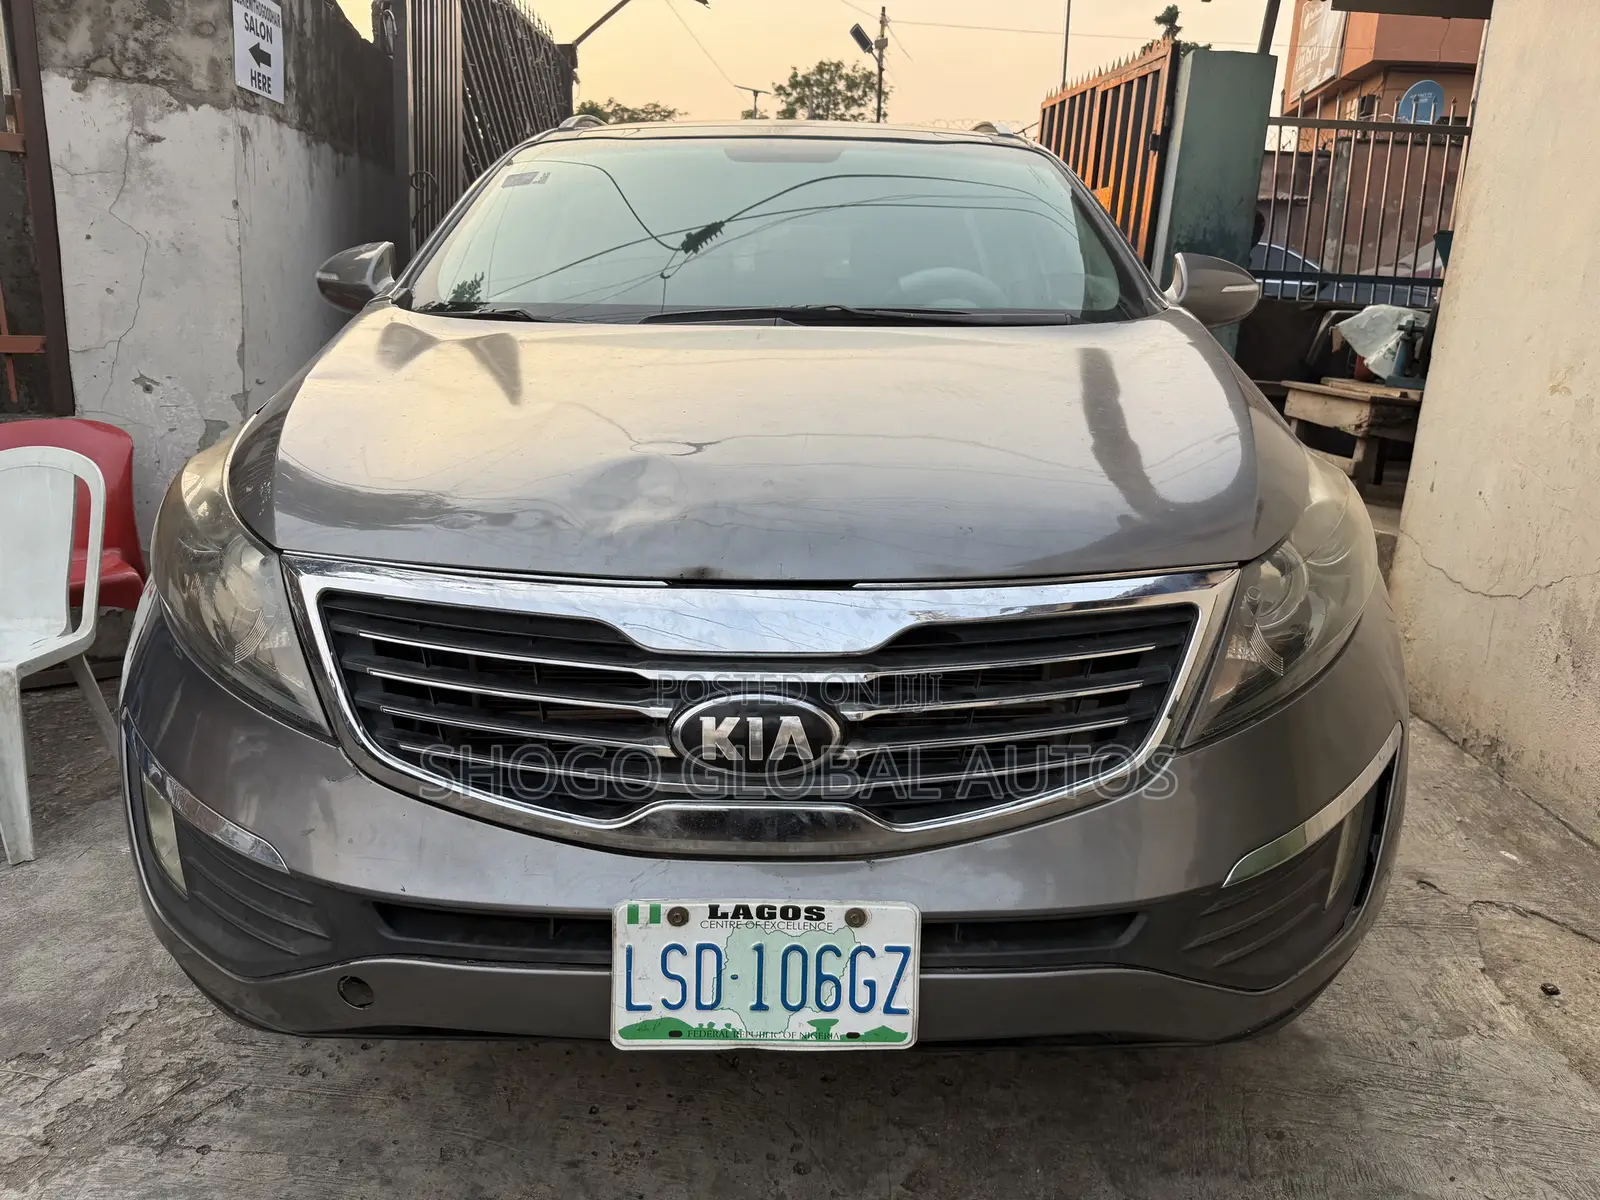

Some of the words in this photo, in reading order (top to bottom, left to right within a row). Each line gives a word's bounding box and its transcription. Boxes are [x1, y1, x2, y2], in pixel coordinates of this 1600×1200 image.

[244, 12, 273, 44] SALON
[250, 68, 272, 94] HERE
[699, 716, 814, 761] KIA
[707, 904, 826, 921] LAGOS
[700, 920, 742, 929] CENTRE
[745, 921, 761, 930] OF
[764, 921, 834, 931] EXCELLENCE
[687, 1030, 730, 1039] FEDERAL
[733, 1030, 782, 1039] REPUBLIC
[783, 1031, 797, 1039] OF
[800, 1031, 840, 1040] NIGERIA
